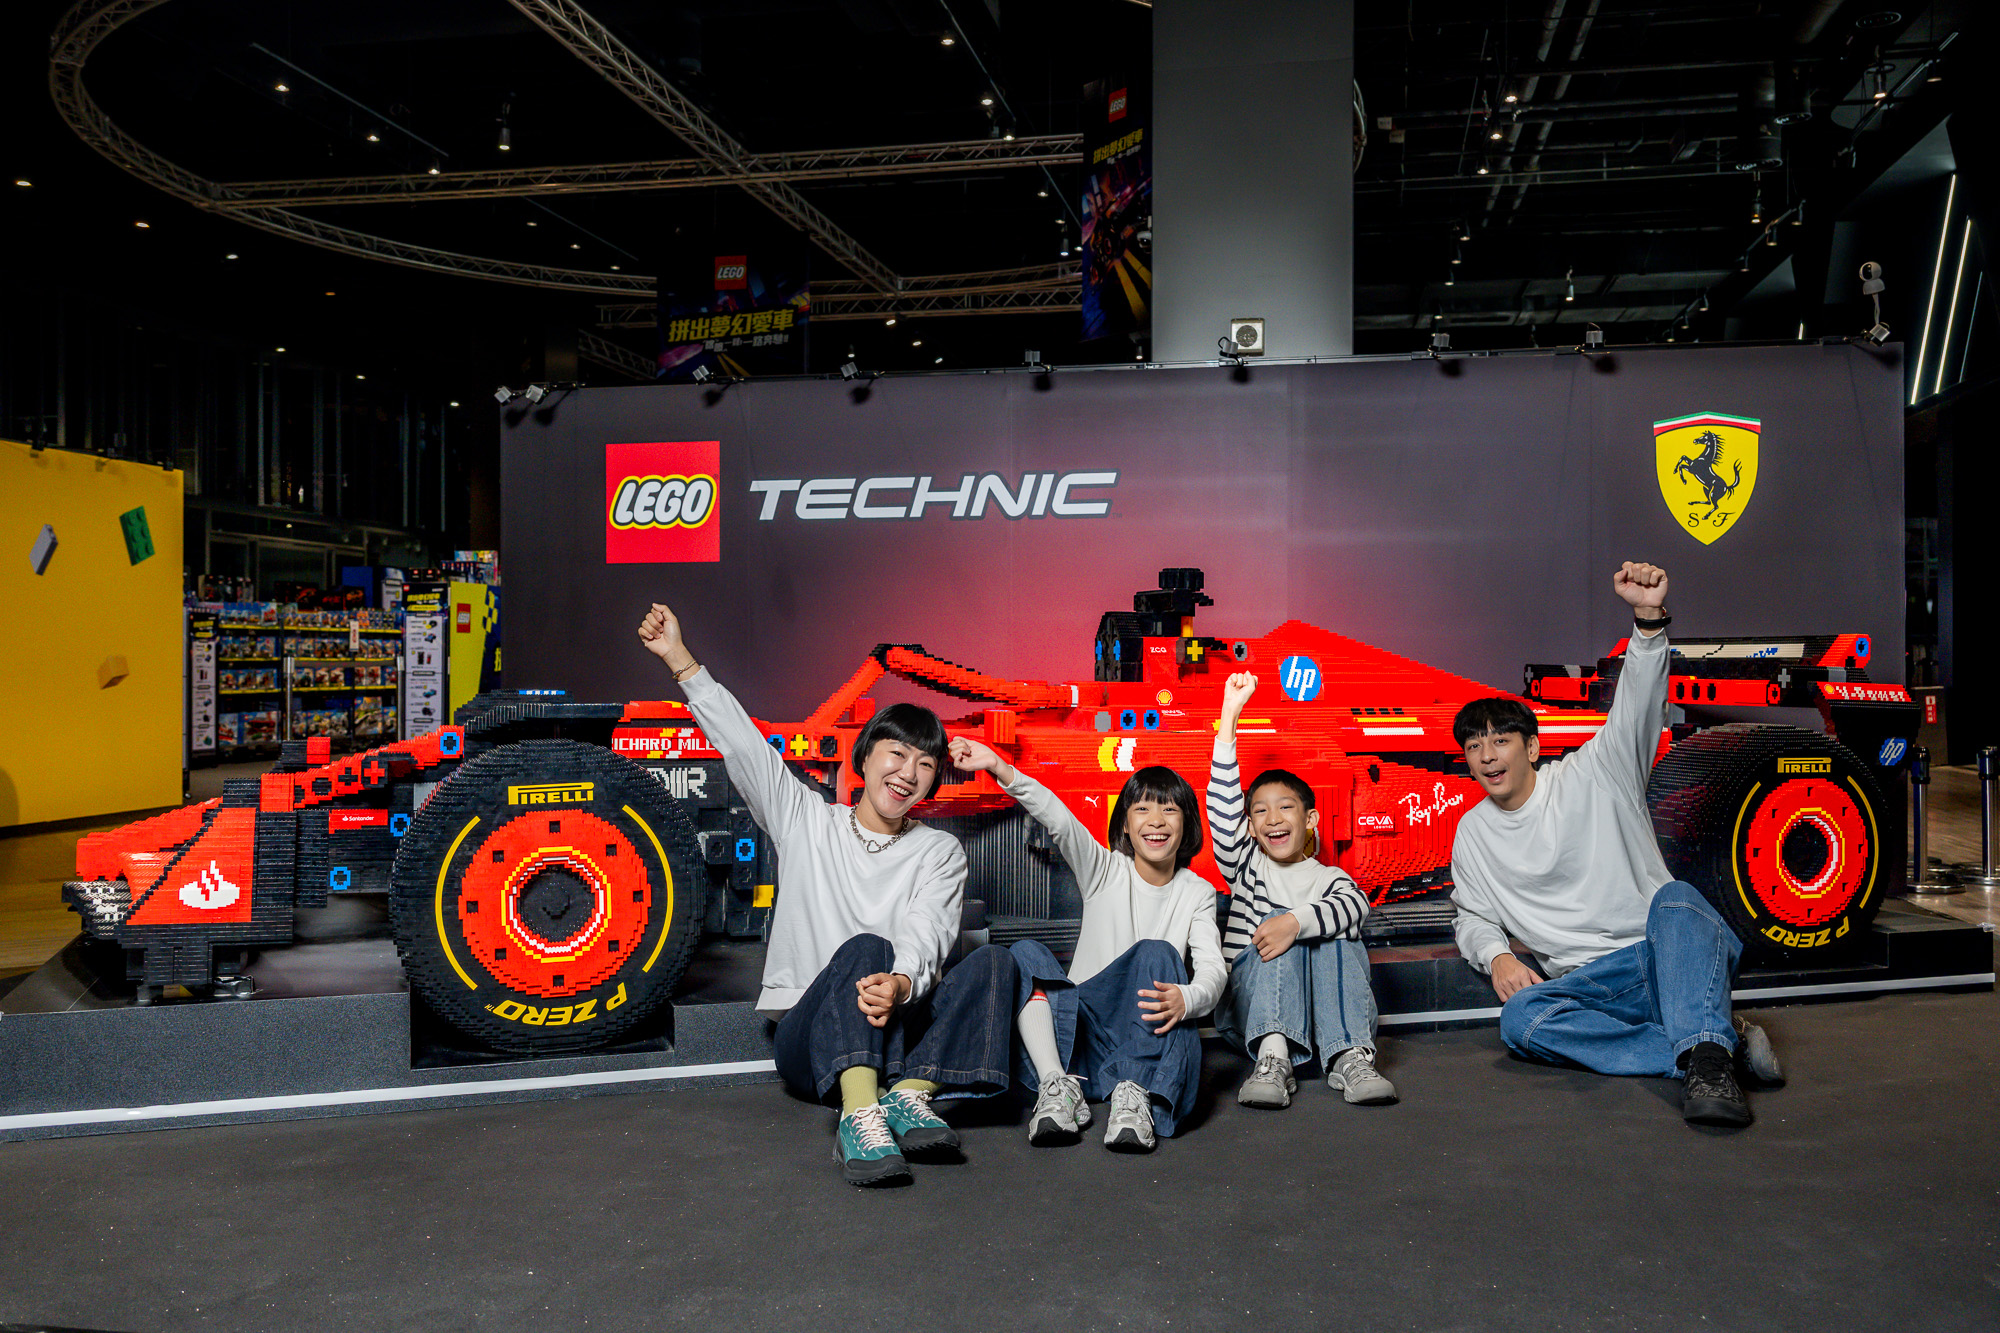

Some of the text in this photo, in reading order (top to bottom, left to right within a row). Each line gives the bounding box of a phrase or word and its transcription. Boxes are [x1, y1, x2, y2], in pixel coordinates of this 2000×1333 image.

[716, 265, 745, 280] LEGO
[667, 308, 794, 343] 拼出夢幻愛車
[613, 478, 712, 527] LEGO
[749, 472, 1117, 520] TECHNIC
[1687, 512, 1700, 527] S
[1285, 656, 1316, 701] hp
[612, 738, 671, 750] ICHARD
[1881, 738, 1904, 765] hp
[1777, 757, 1832, 773] PIRELLI
[508, 781, 594, 805] PIRELLI
[1765, 915, 1850, 947] P ZERO
[606, 982, 627, 1011] P
[493, 999, 597, 1025] ZERO
